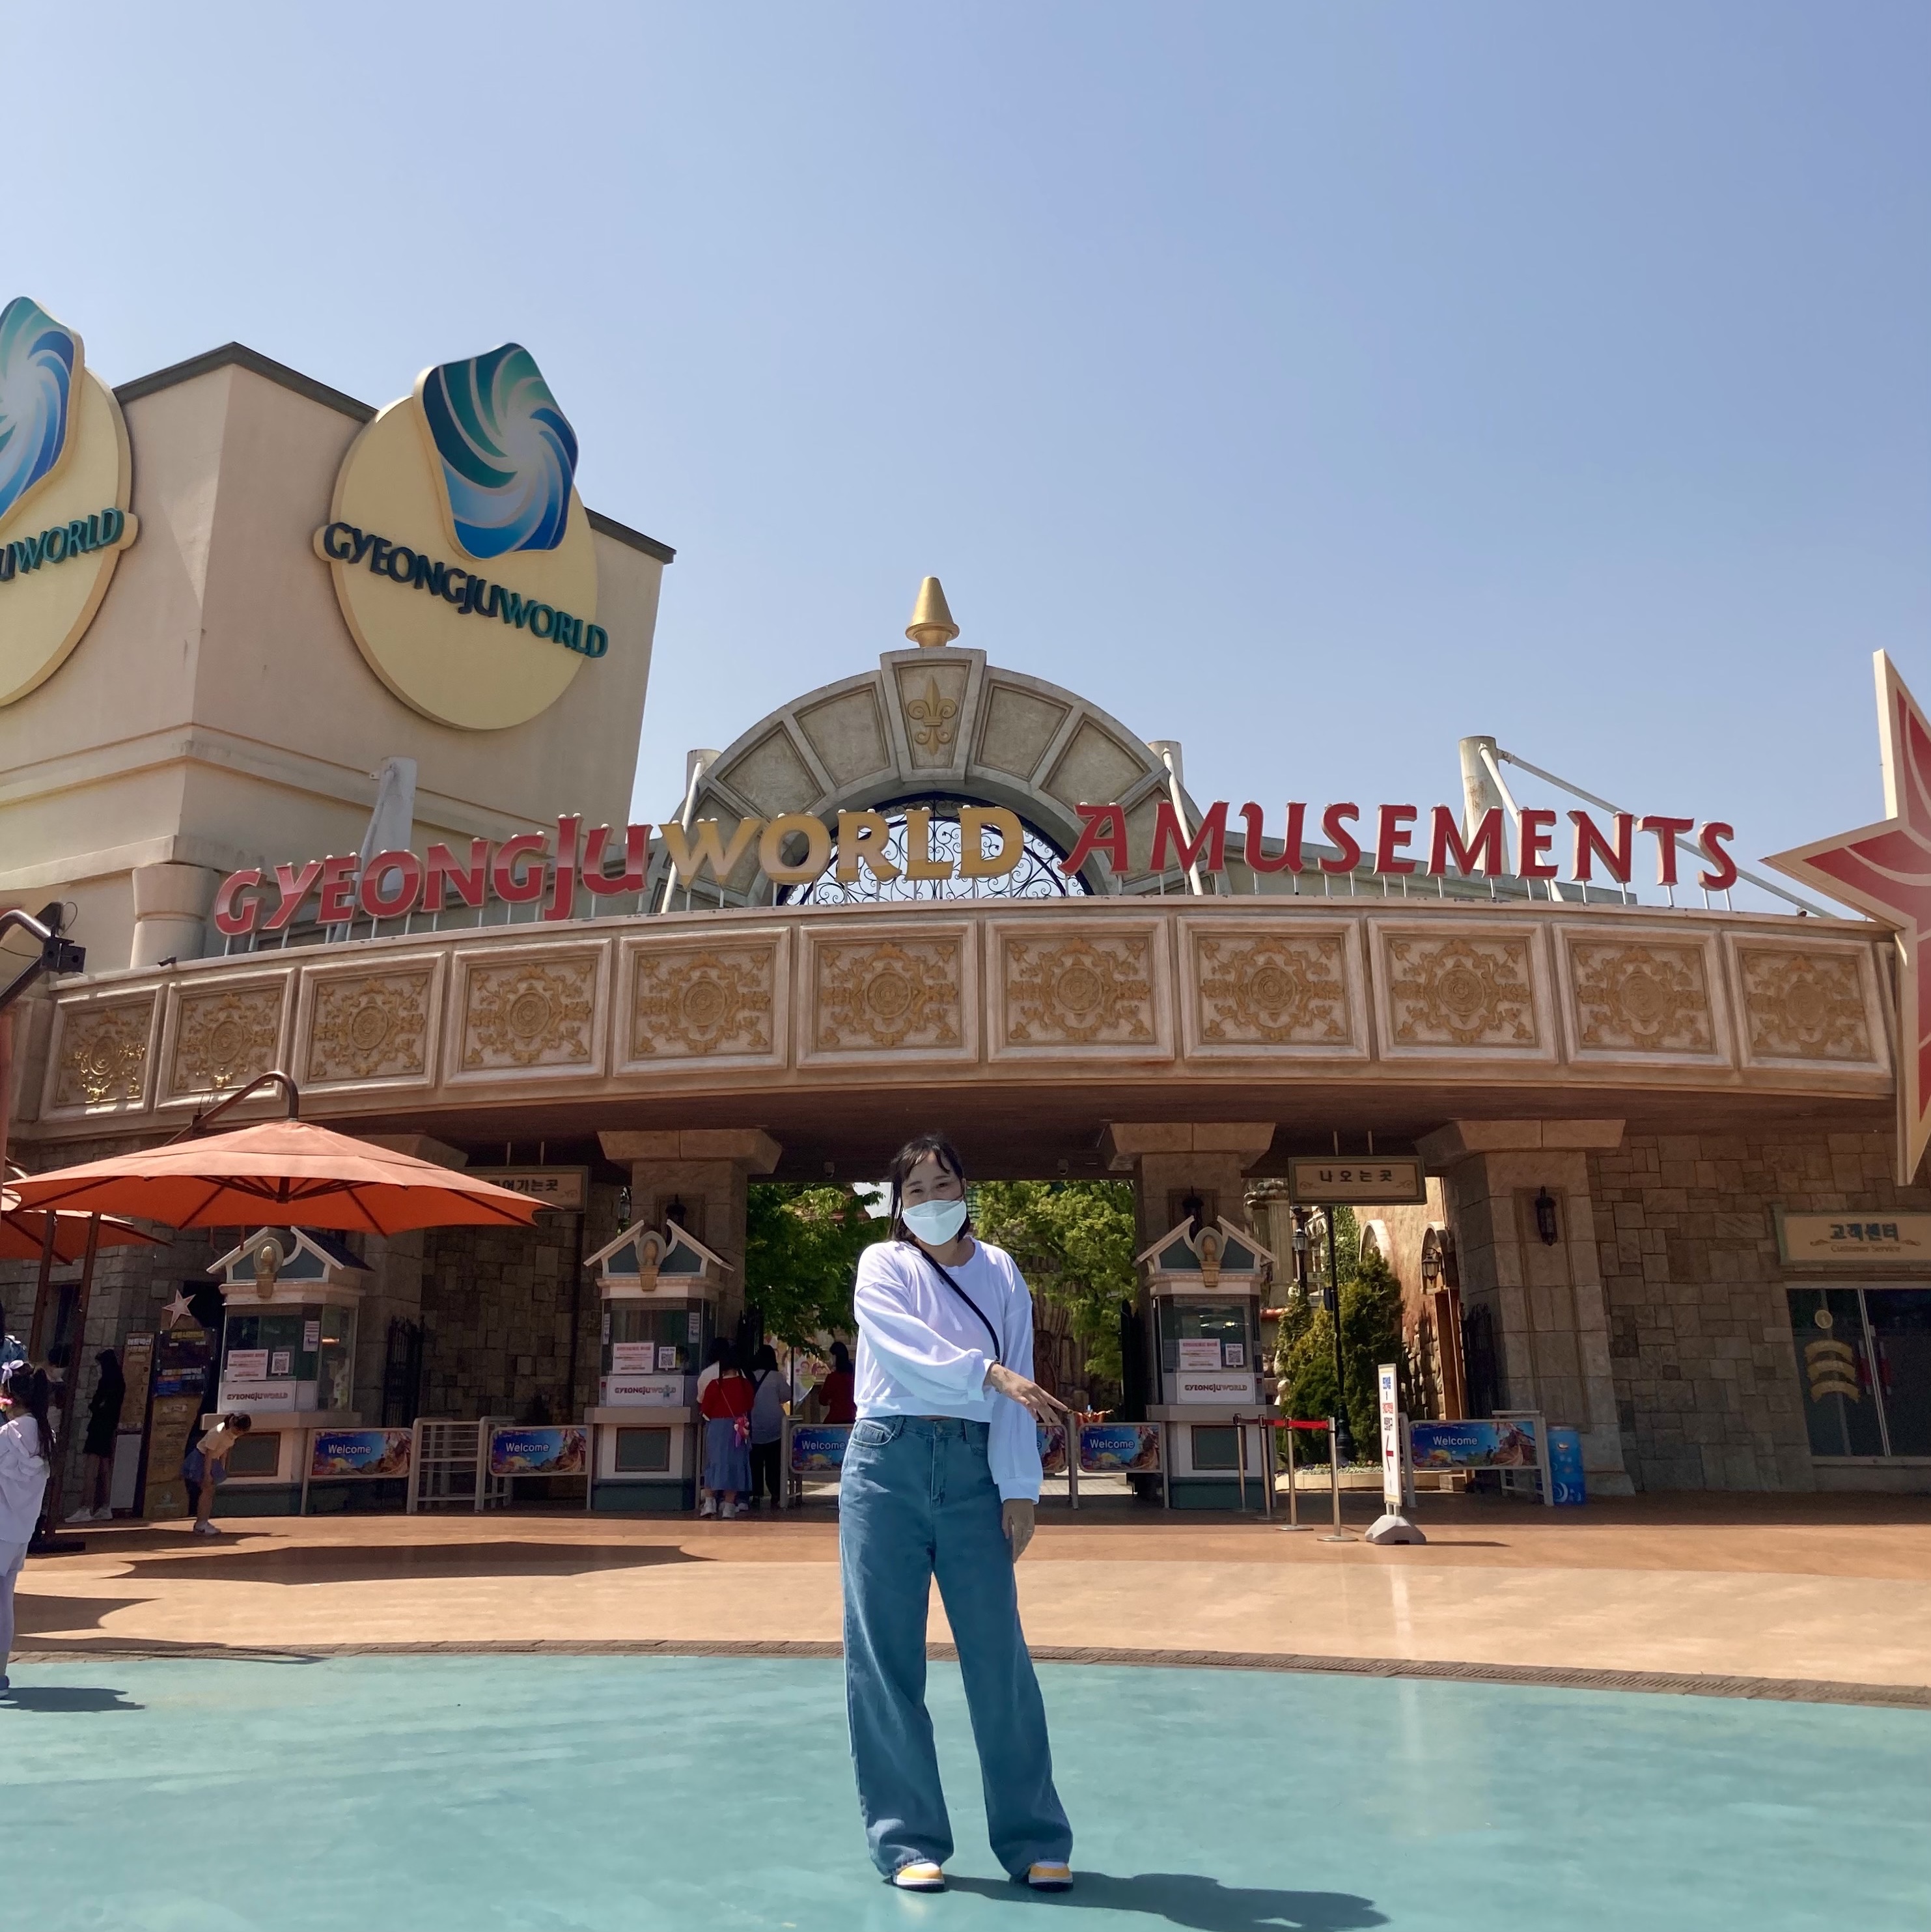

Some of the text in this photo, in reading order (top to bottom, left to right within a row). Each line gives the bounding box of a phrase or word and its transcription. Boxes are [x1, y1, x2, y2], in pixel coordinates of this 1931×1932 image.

[324, 522, 609, 658] GYEONGJUWORLD
[215, 800, 1737, 936] GYEONGJU WORLD AMUSEMENTS
[1829, 1222, 1899, 1241] 고객센터
[801, 1440, 845, 1450] Welcome
[1090, 1438, 1135, 1449] Welcome
[1433, 1436, 1478, 1446] Welcome
[328, 1444, 372, 1454] Welcome
[506, 1442, 549, 1452] Welcome
